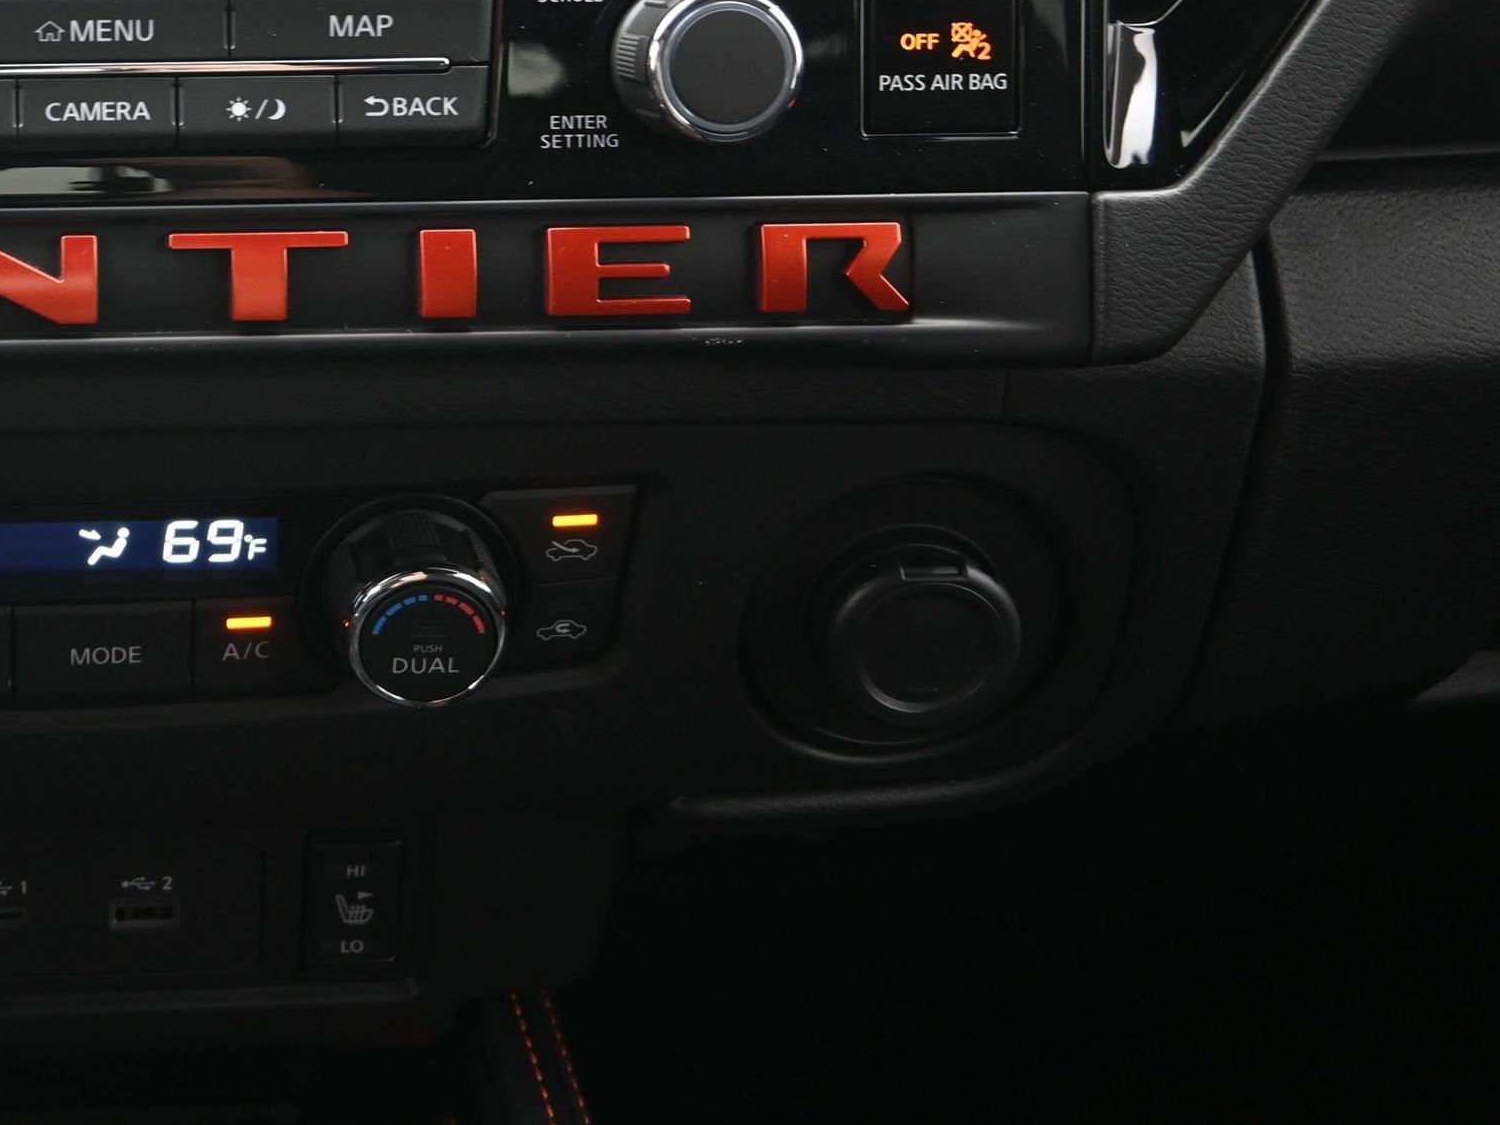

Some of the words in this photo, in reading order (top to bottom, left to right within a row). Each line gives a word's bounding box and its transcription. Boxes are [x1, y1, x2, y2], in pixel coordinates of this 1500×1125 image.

[69, 19, 156, 44] MENU
[328, 14, 394, 39] MAP
[900, 32, 941, 51] OFF
[878, 74, 927, 92] PASS
[930, 73, 964, 91] AIR
[968, 72, 1008, 90] BAG
[44, 101, 151, 122] CAMERA
[392, 95, 459, 117] BACK
[549, 114, 608, 130] ENTER
[540, 133, 620, 150] SETTING
[70, 645, 143, 666] MODE
[222, 641, 271, 662] A/C
[412, 644, 443, 653] PUSH
[392, 656, 460, 674] DUAL
[346, 864, 366, 878] HI
[19, 881, 28, 894] 1
[161, 876, 173, 891] 2
[340, 939, 365, 954] LO
